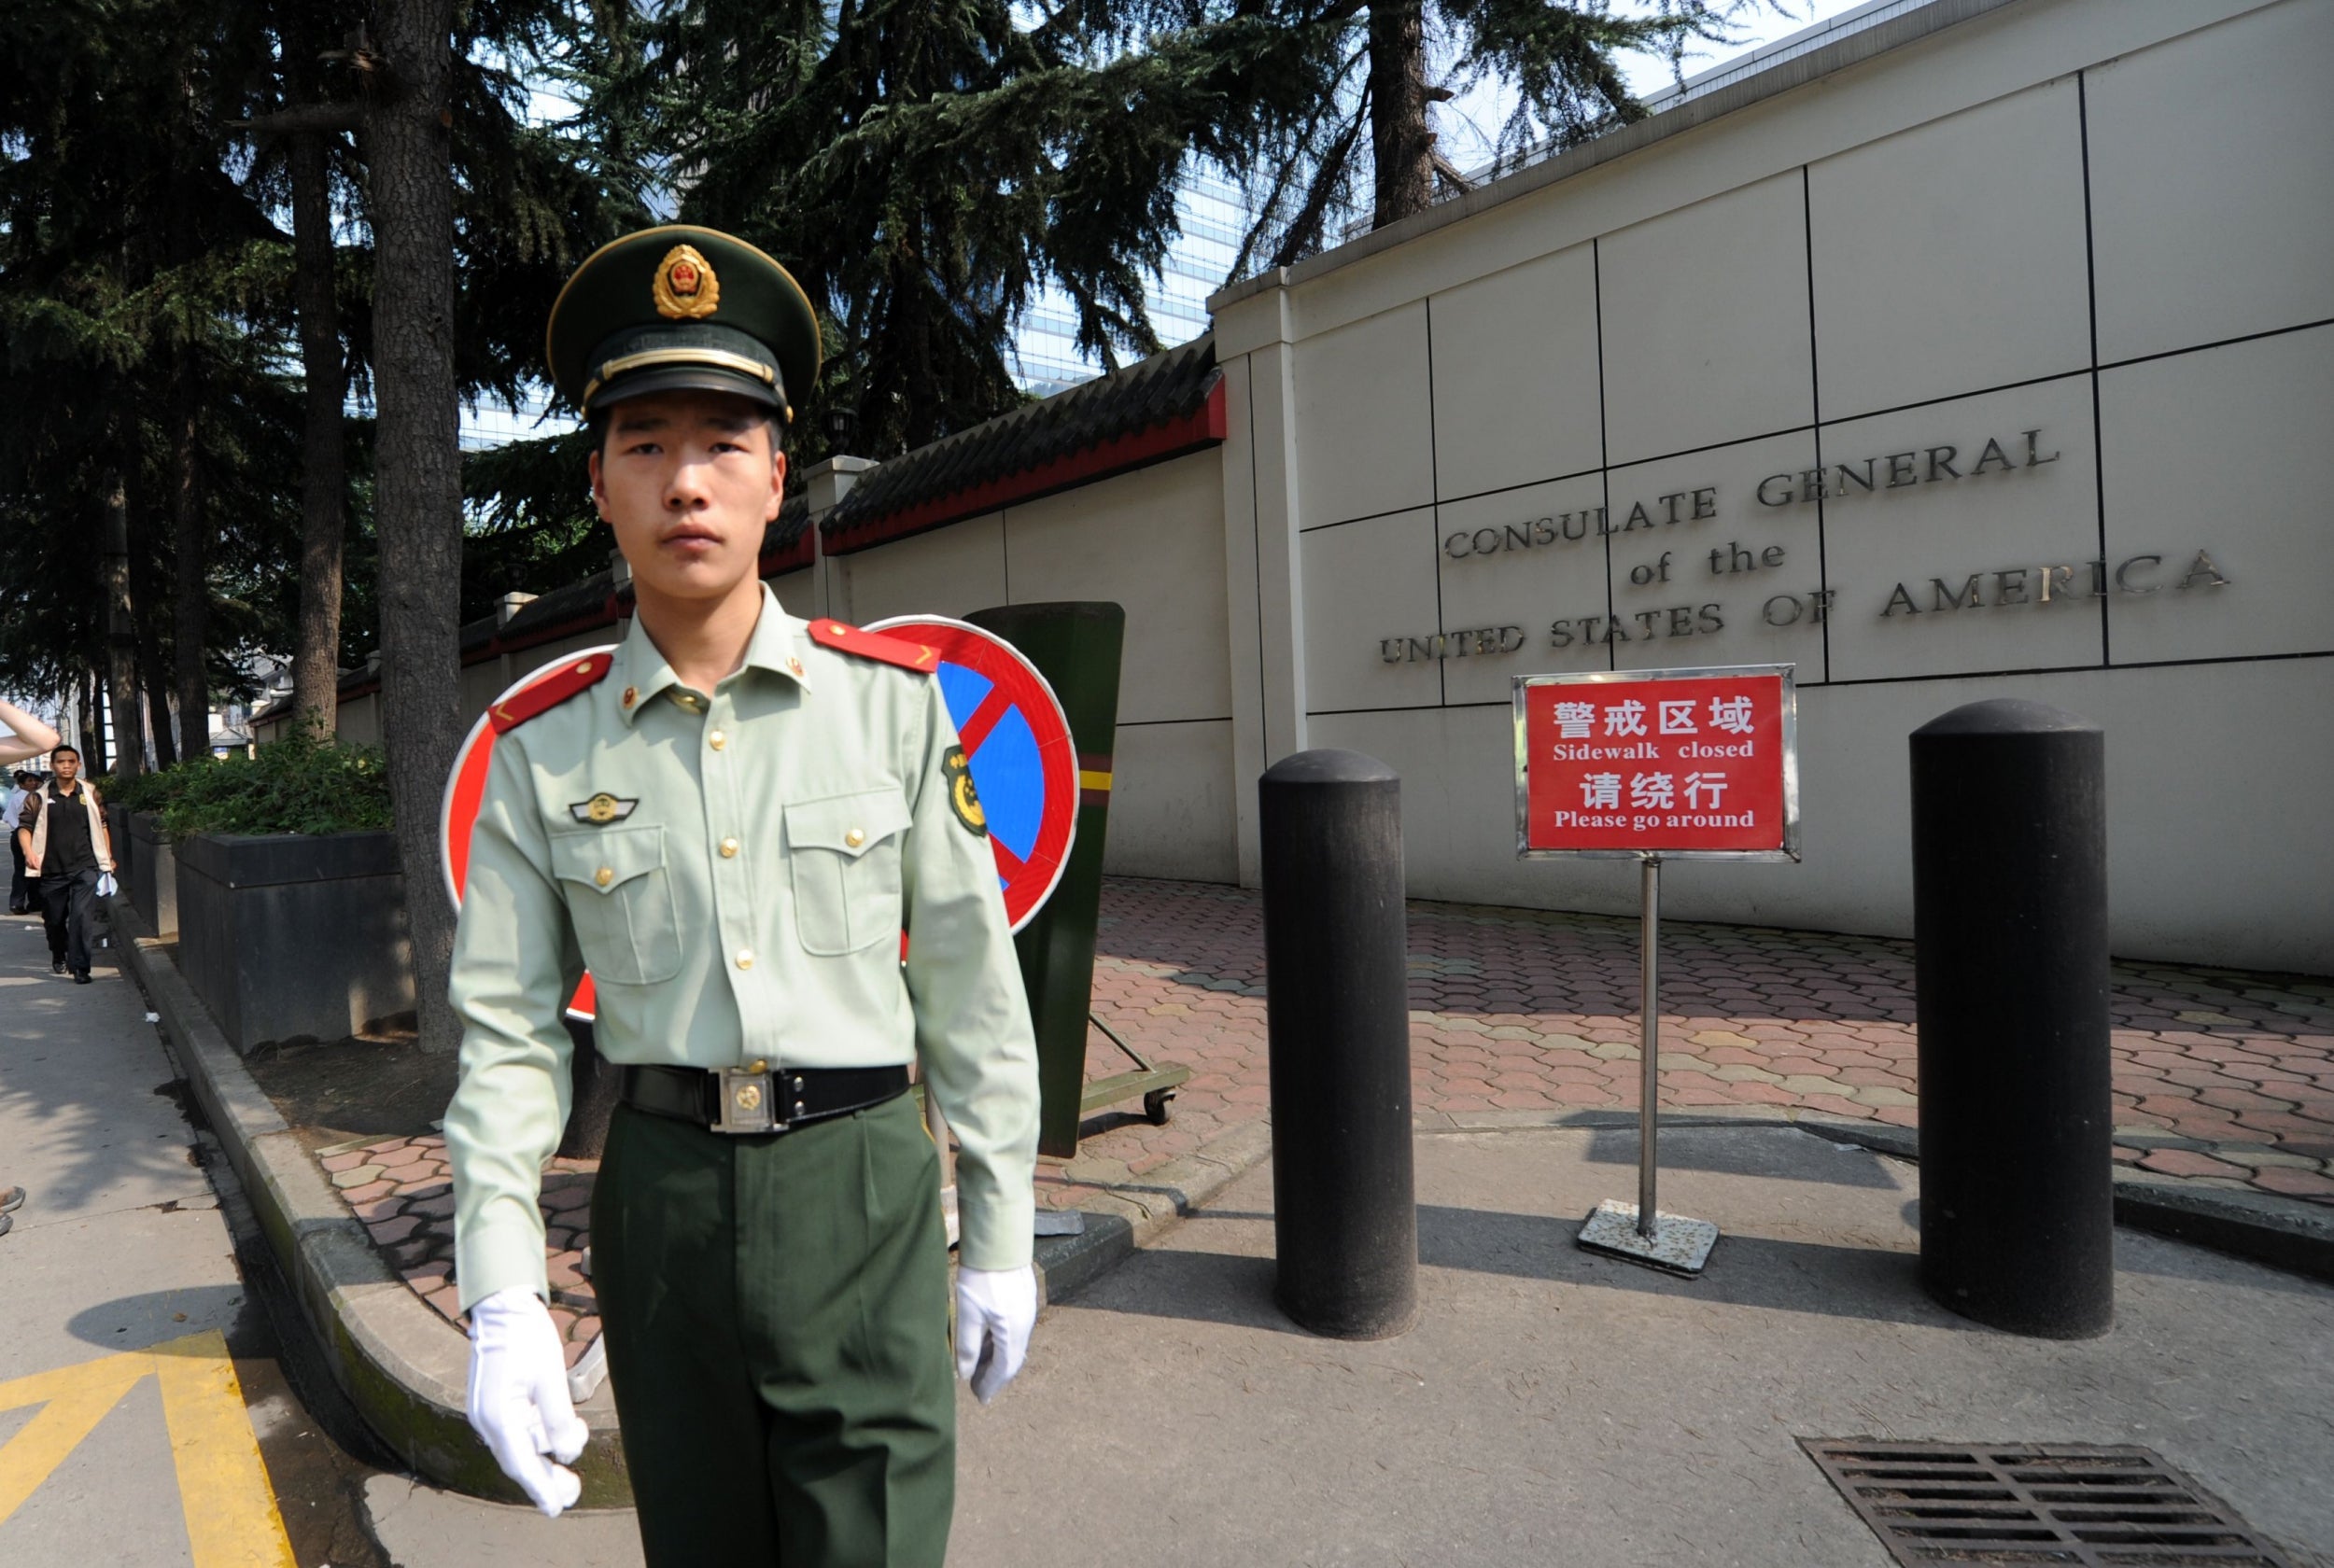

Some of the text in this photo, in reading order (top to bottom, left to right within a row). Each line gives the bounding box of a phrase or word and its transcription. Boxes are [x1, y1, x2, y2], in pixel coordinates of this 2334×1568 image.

[1445, 429, 2060, 558] CONSULATE GENERAL
[1630, 541, 1785, 585] of the
[1380, 549, 2230, 663] UNITED STATES OF AMERICA
[1553, 695, 1754, 738] 警戒区域
[1553, 740, 1753, 761] Sidewalk closed
[1579, 771, 1727, 810] 请绕行
[1554, 810, 1754, 831] Please go around
